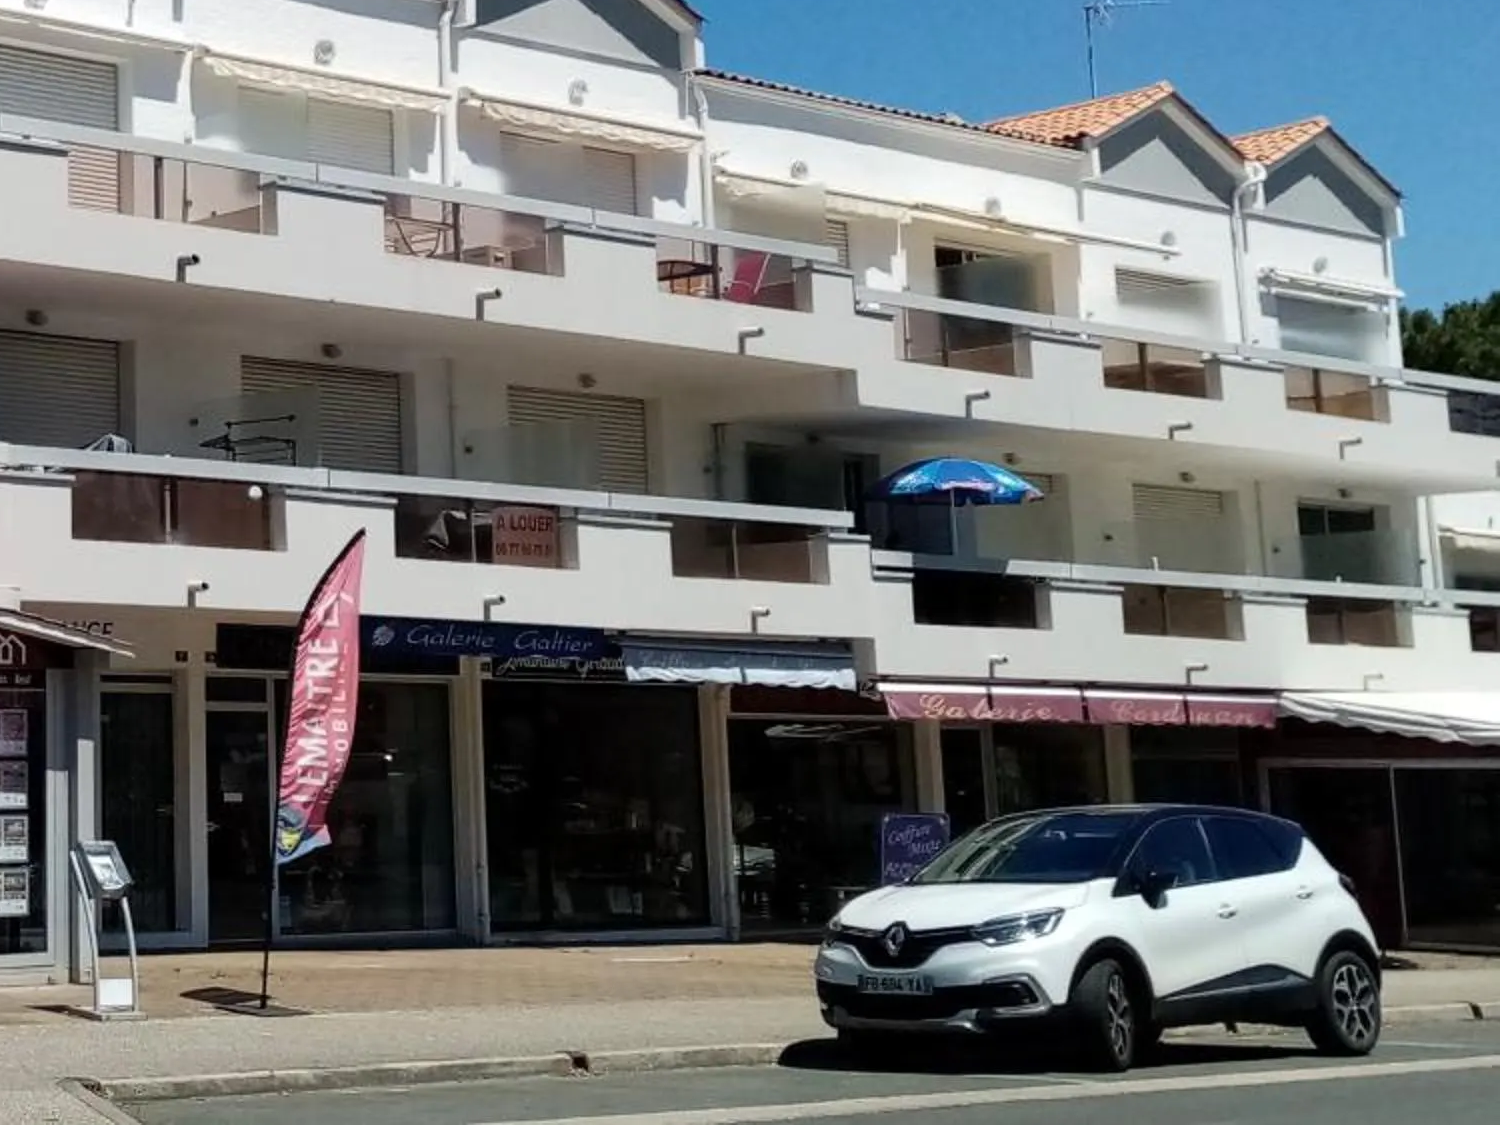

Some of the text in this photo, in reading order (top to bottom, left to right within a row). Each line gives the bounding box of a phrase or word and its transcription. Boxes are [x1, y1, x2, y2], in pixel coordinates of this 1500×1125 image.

[509, 515, 554, 533] LOUER
[405, 623, 496, 648] Galerie
[919, 693, 1054, 720] Galerie
